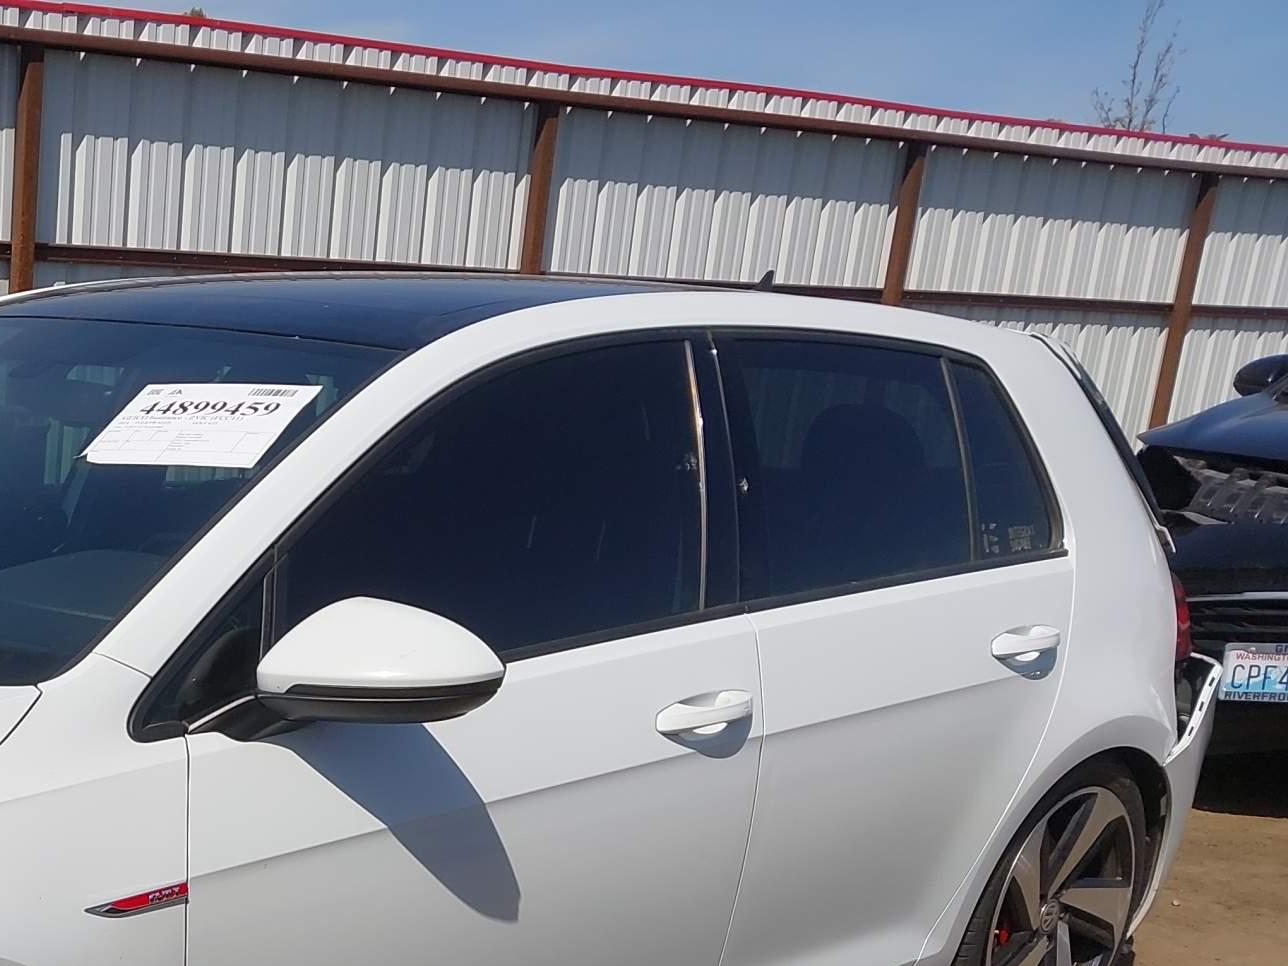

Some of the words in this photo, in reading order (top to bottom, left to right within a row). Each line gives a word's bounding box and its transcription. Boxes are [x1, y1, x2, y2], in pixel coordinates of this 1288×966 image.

[140, 400, 281, 417] 44899459
[1236, 652, 1288, 661] WASHINGT
[1224, 691, 1288, 701] RIVERFRO
